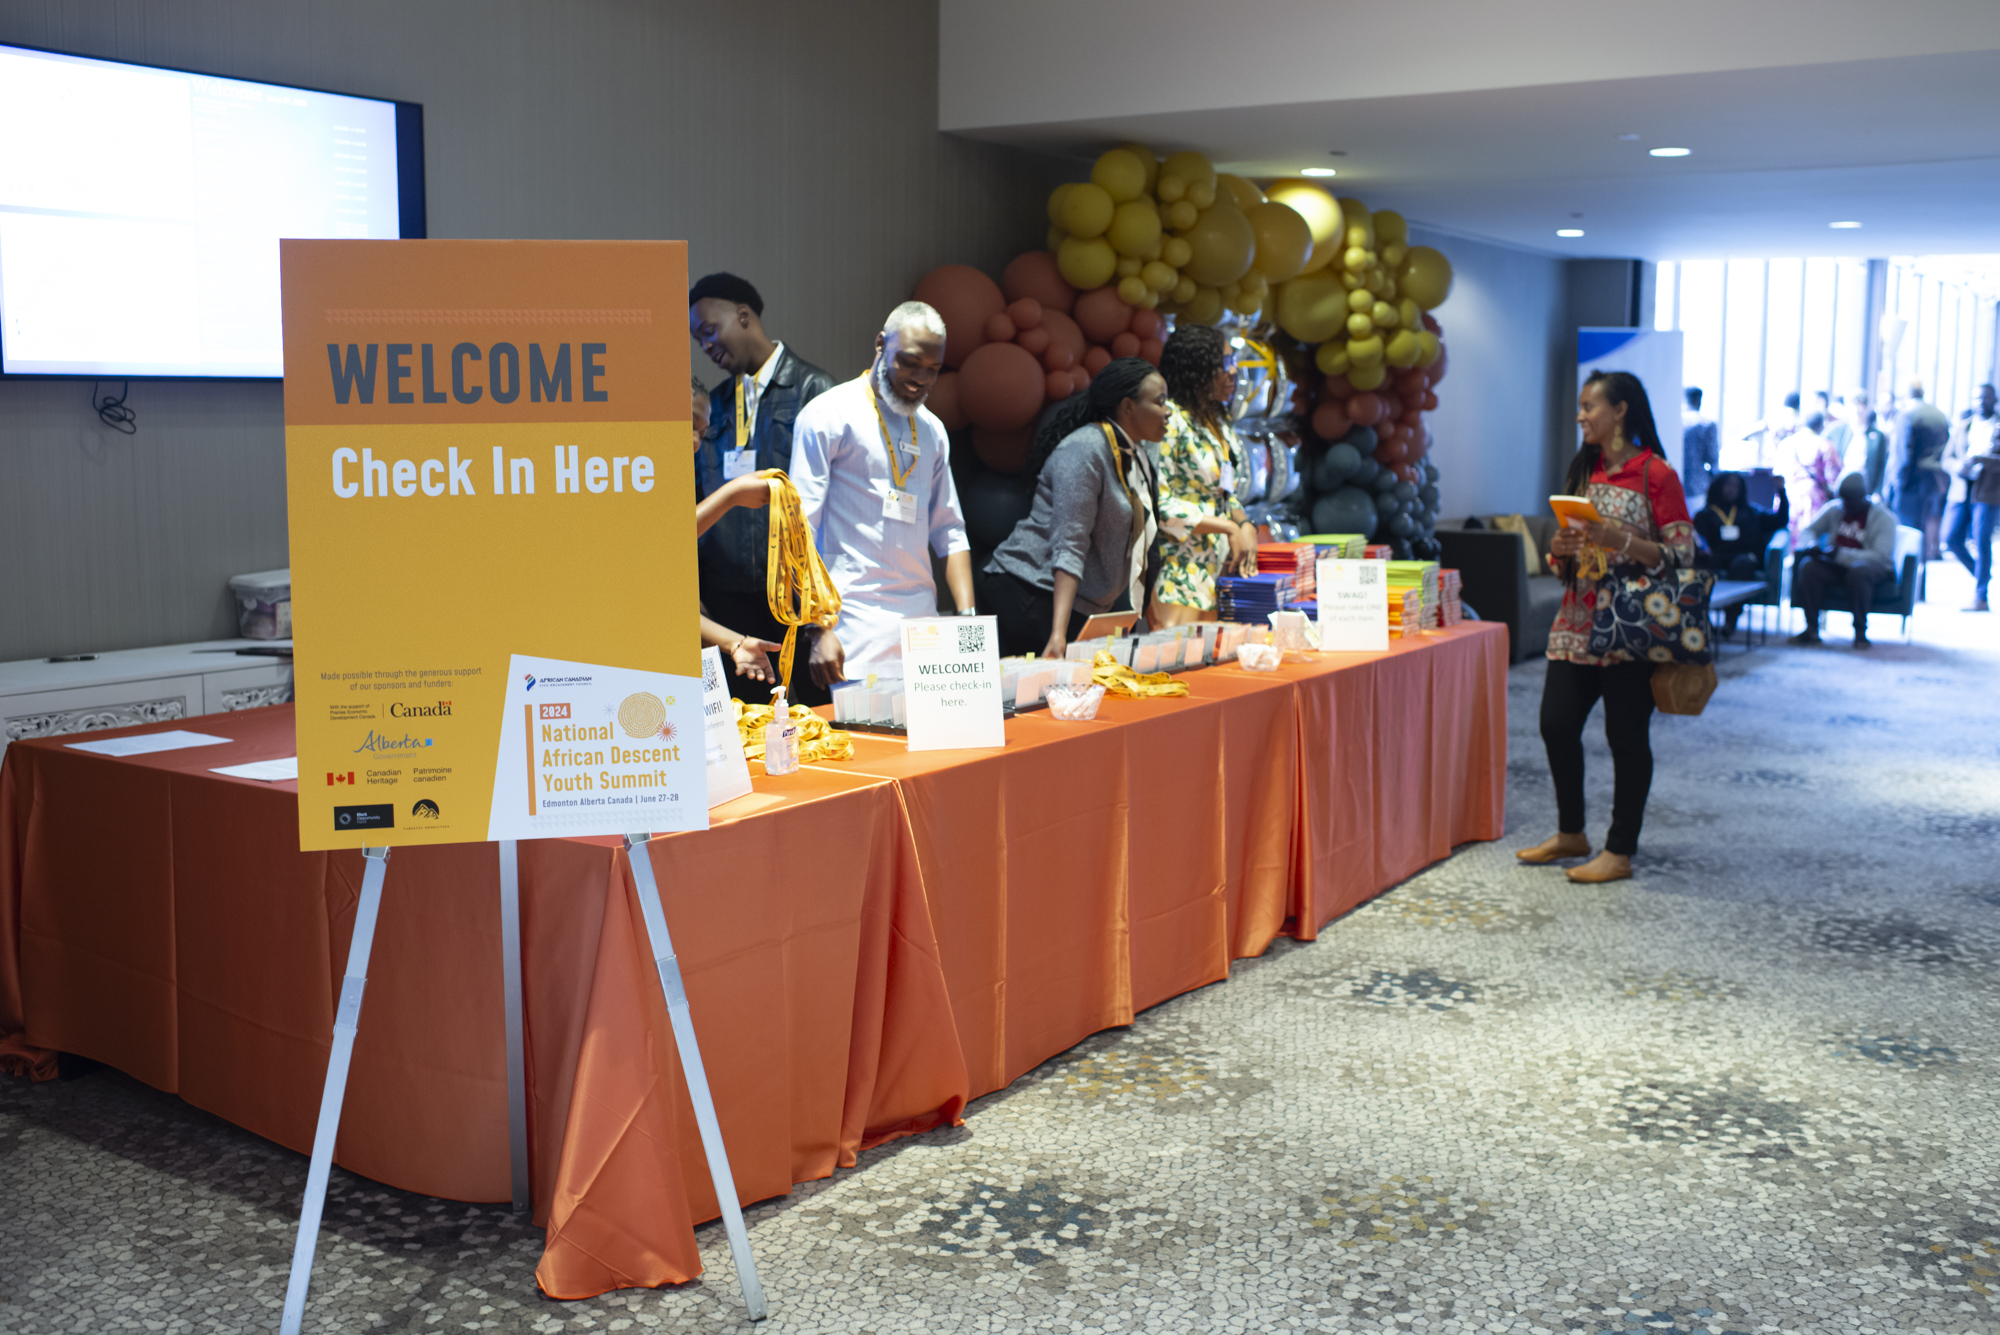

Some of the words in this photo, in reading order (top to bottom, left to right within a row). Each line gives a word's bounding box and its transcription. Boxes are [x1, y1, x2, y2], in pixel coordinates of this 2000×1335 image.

[191, 77, 263, 102] Welcome
[327, 342, 608, 404] WELCOME
[332, 446, 476, 498] Check
[493, 446, 535, 494] In
[554, 445, 654, 494] Here
[320, 672, 340, 680] Made
[342, 670, 373, 682] possible
[374, 670, 404, 680] through
[405, 669, 418, 678] the
[419, 670, 452, 678] generous
[454, 668, 482, 677] support
[918, 662, 984, 675] WELCOME!
[350, 682, 358, 690] of
[374, 682, 406, 692] sponsors
[408, 680, 422, 688] and
[424, 679, 454, 688] funders:
[914, 681, 947, 692] Please
[950, 680, 992, 690] check-in
[390, 701, 452, 718] Canada
[704, 701, 722, 717] WIFI!
[941, 698, 967, 707] here.
[542, 706, 568, 718] 2024
[542, 722, 614, 742] National
[353, 730, 424, 753] Alberta
[542, 749, 604, 767] African
[611, 745, 680, 764] Descent
[366, 769, 402, 777] Canadian
[366, 776, 398, 785] Heritage
[543, 772, 593, 792] Youth
[600, 770, 667, 790] Summit
[542, 798, 578, 808] Edmonton
[580, 797, 605, 806] Alberta
[608, 796, 633, 805] Canada
[640, 795, 656, 803] June
[658, 794, 678, 802] 27-28
